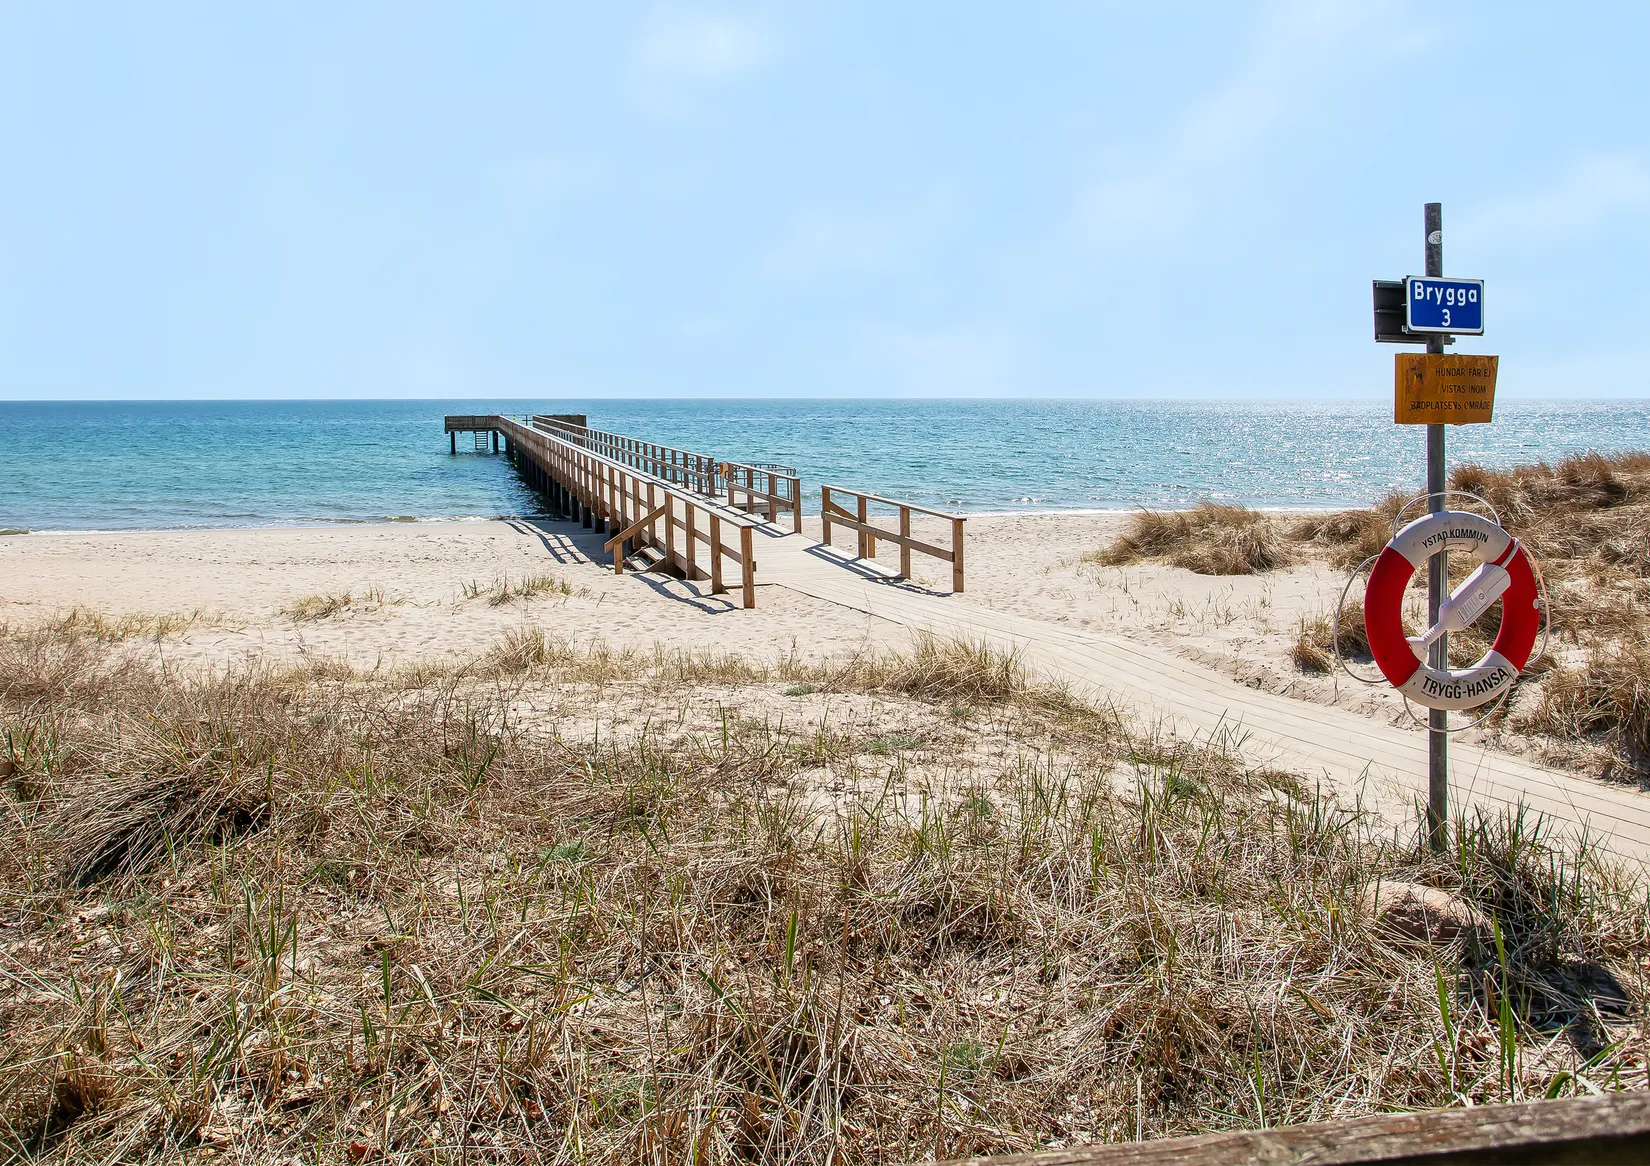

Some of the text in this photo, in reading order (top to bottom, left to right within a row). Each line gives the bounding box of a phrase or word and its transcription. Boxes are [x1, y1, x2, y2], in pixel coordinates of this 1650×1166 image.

[1415, 282, 1477, 306] Brygga
[1441, 308, 1451, 326] 3
[1435, 367, 1465, 377] HUNDAR
[1484, 368, 1491, 378] EJ
[1441, 384, 1486, 393] VISTAS INOM
[1422, 528, 1489, 549] YSTAD KOMMUN
[1422, 667, 1508, 699] TRYGG-HANSA
